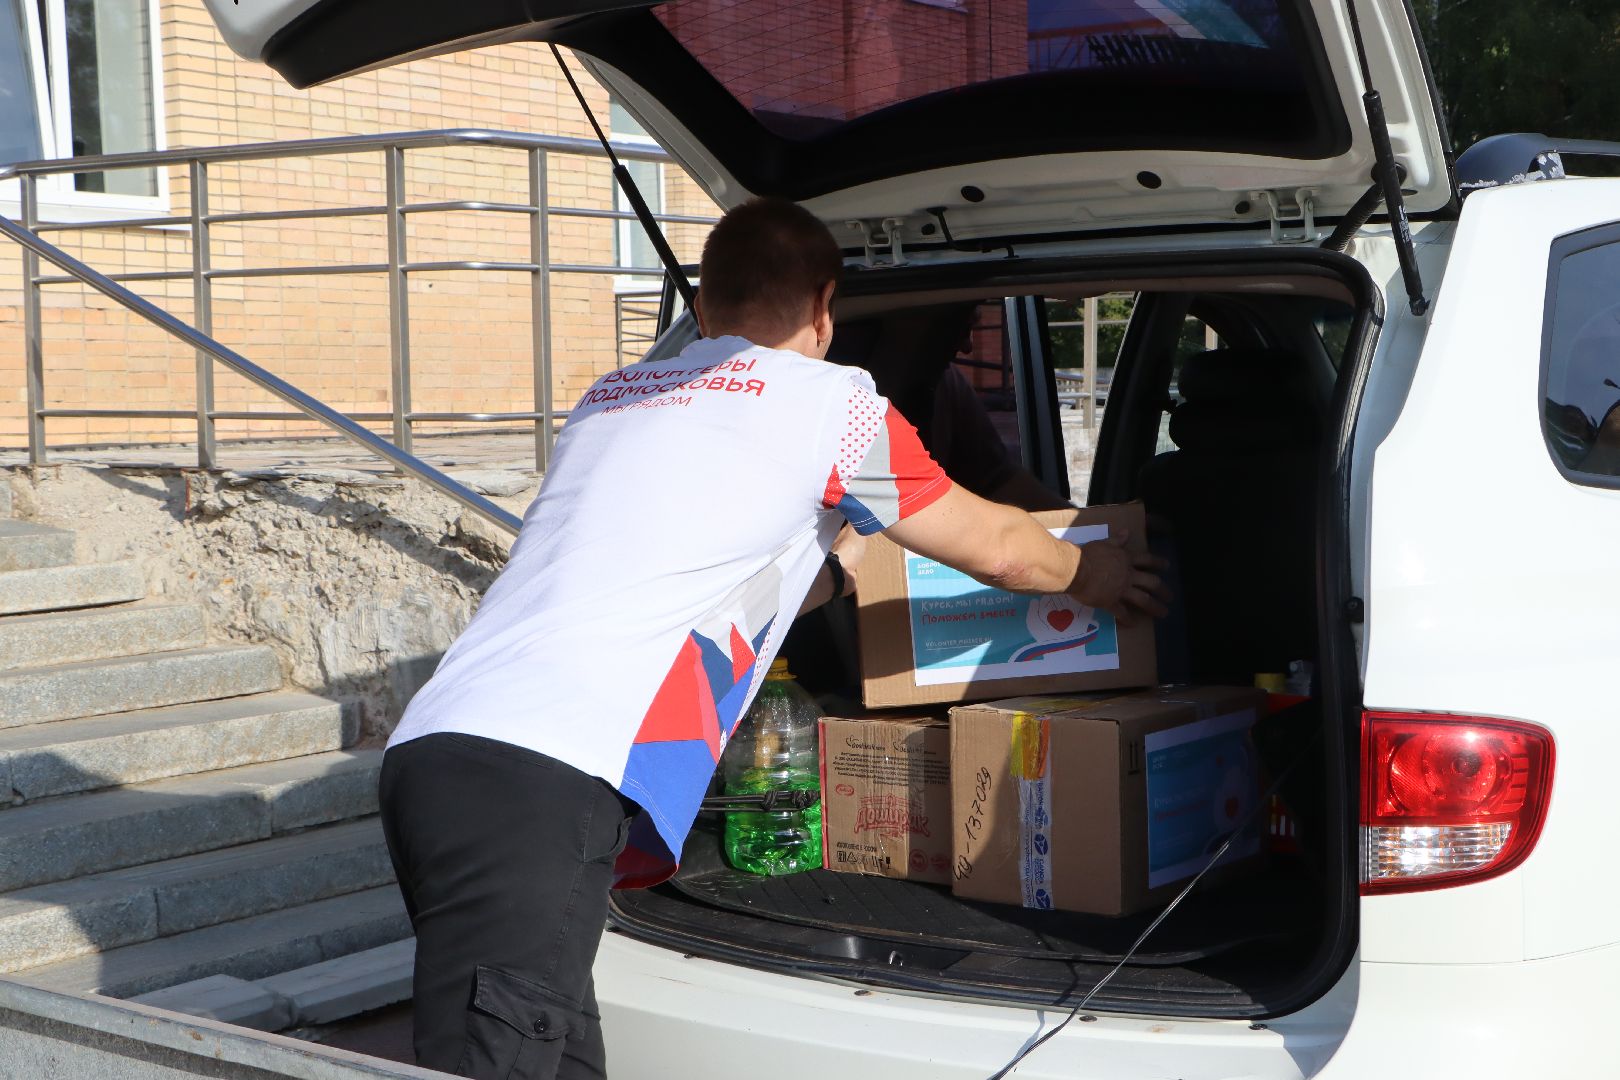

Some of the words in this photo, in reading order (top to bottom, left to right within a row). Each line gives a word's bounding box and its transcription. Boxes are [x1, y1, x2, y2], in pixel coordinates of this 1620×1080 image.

[578, 376, 766, 410] ПОДМОСКОВЬЯ
[601, 402, 628, 416] МЫ
[629, 396, 693, 412] РЯДОМ
